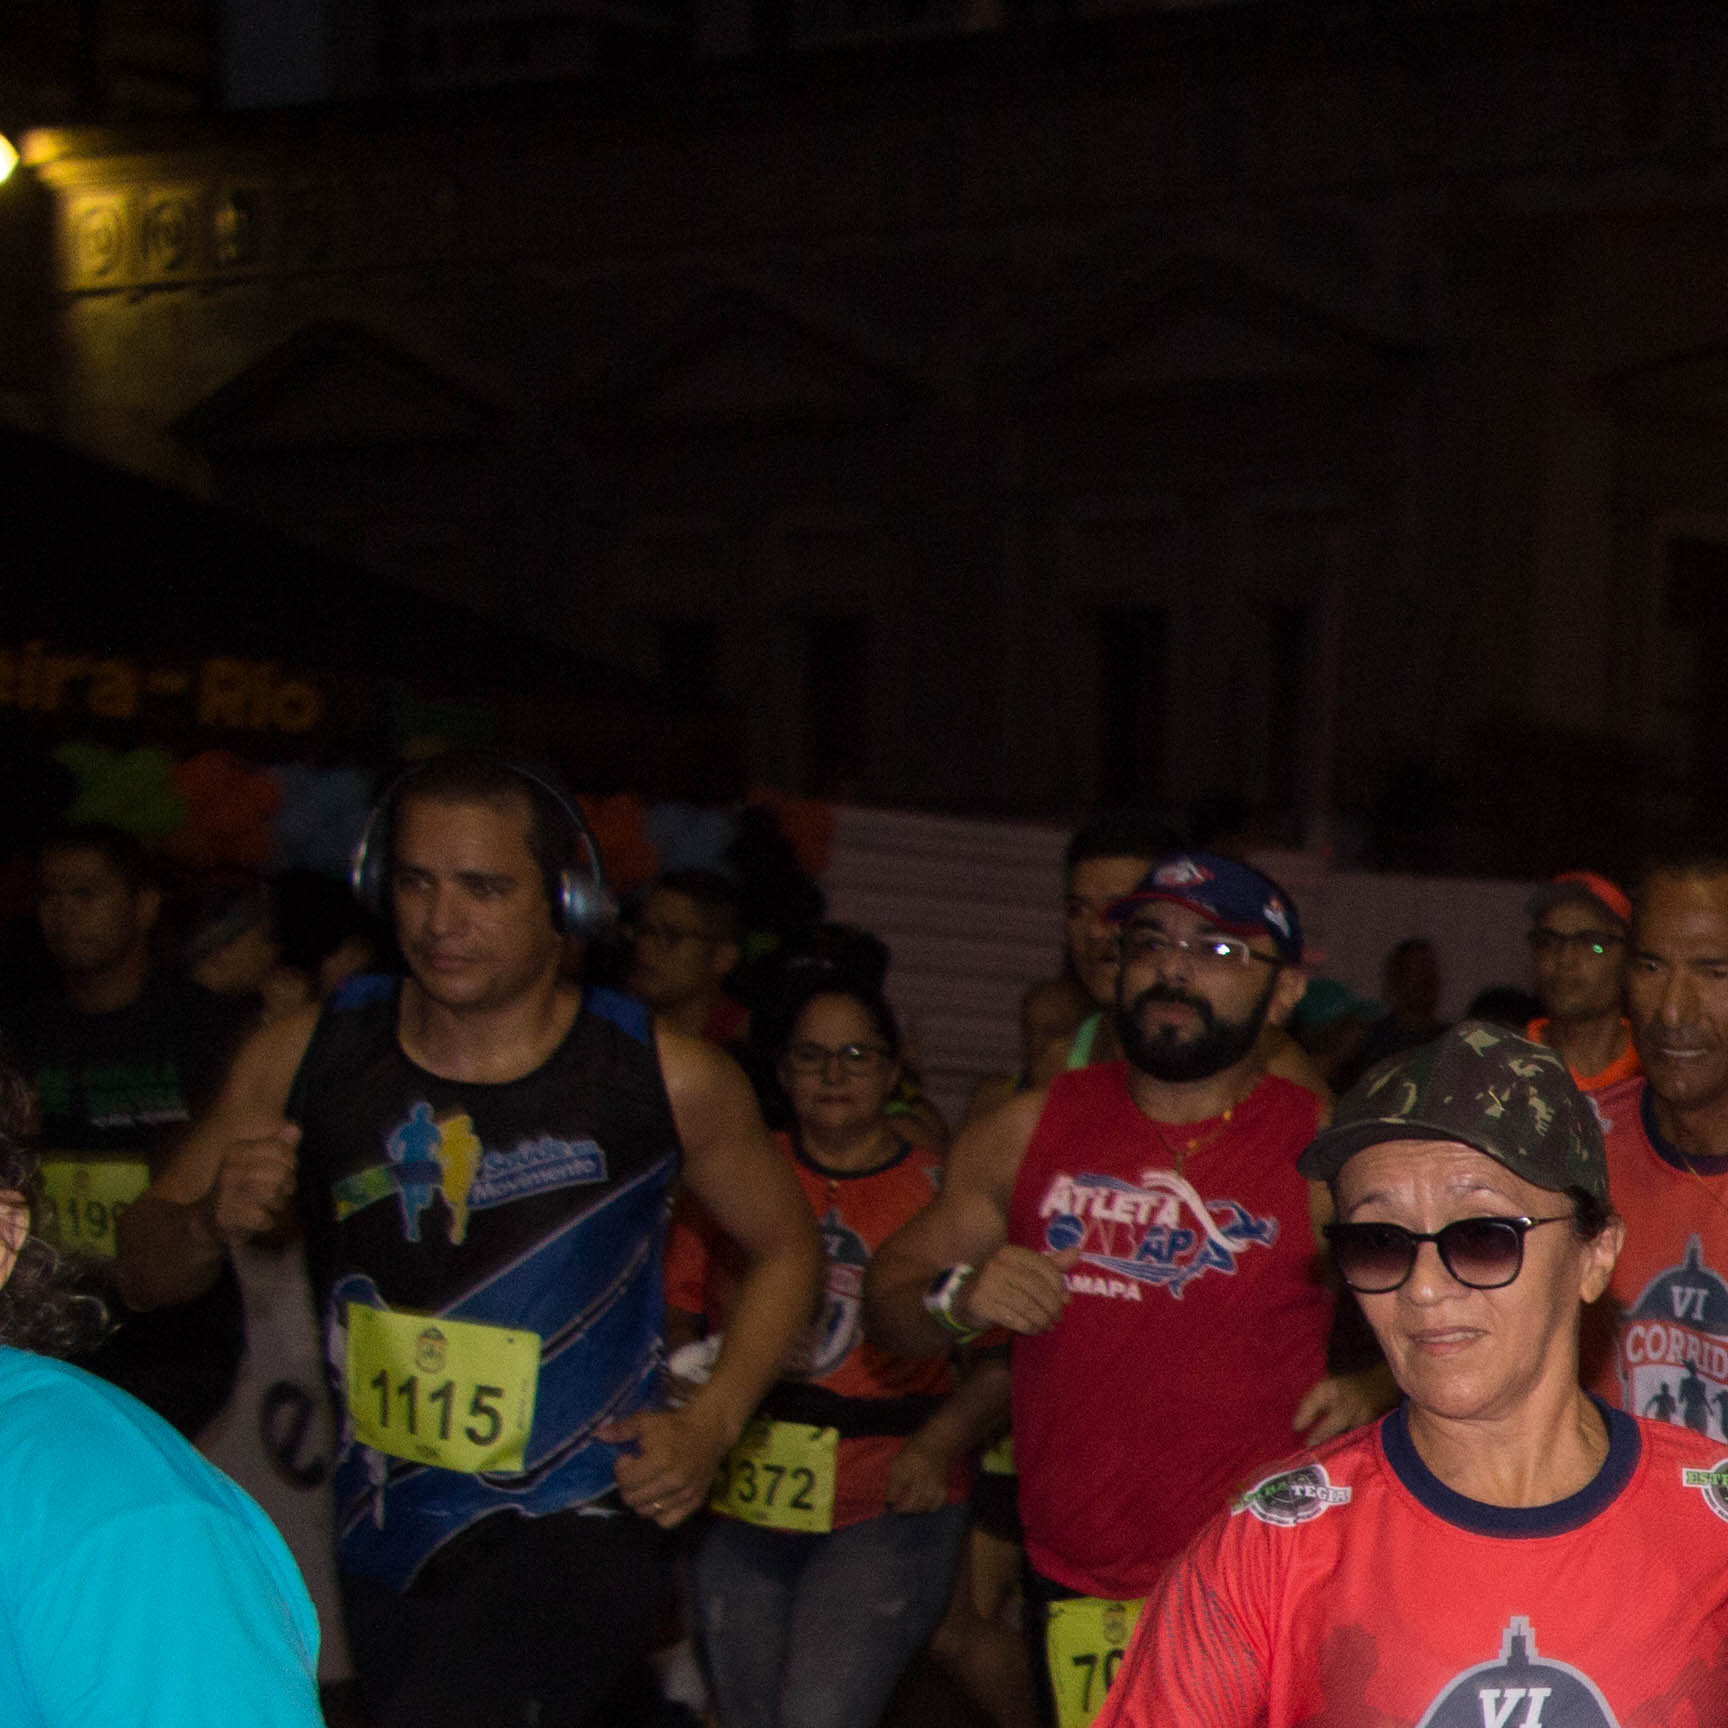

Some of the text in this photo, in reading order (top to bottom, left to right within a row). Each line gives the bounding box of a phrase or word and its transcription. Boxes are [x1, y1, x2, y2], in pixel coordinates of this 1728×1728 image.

[1038, 1176, 1182, 1230] ATLETA
[1671, 1283, 1706, 1323] VI
[368, 1371, 505, 1447] 1115
